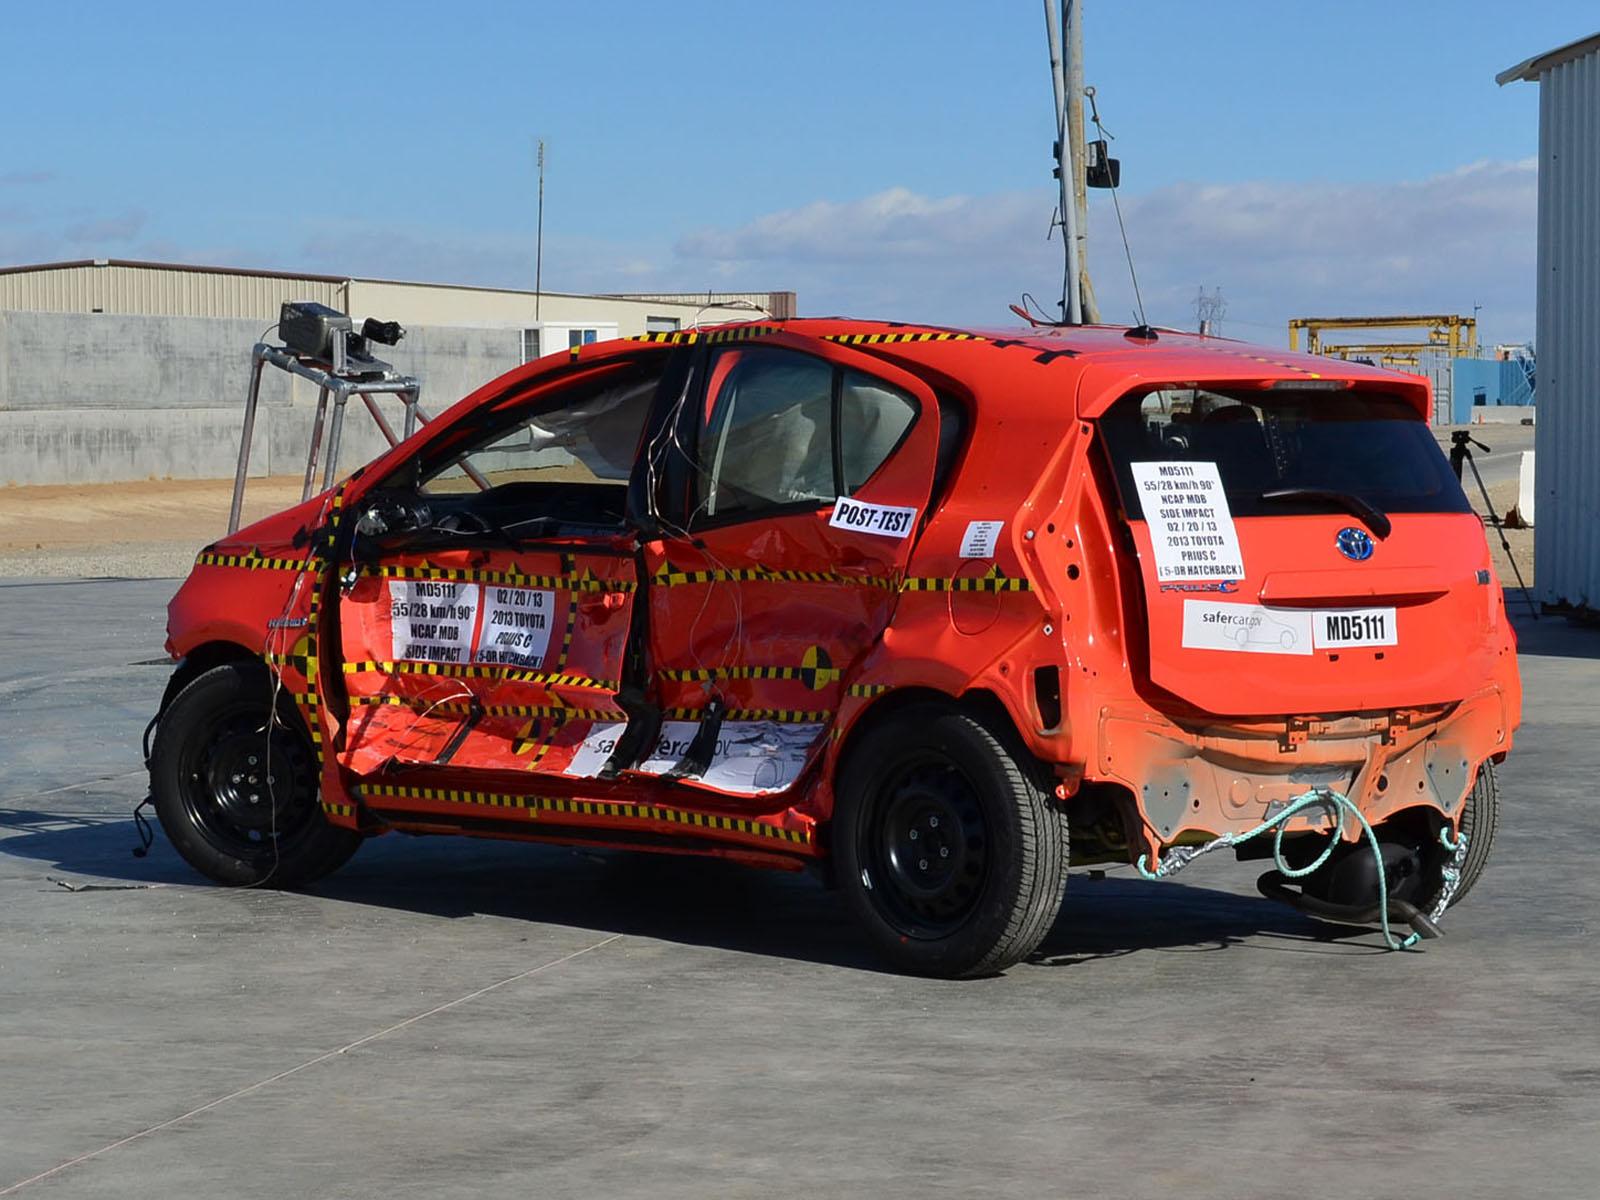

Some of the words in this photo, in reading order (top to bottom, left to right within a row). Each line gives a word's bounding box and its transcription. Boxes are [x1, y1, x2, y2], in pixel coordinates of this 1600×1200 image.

[1159, 466, 1194, 476] MD5111
[1144, 481, 1173, 491] 55/28
[1174, 481, 1199, 490] km/h
[1161, 494, 1185, 504] NCAP
[1187, 494, 1207, 504] MDB
[836, 502, 911, 532] POST-TEST
[1160, 509, 1181, 519] SIDE
[1182, 508, 1215, 518] IMPACT
[1167, 536, 1190, 547] 2013
[1190, 536, 1225, 546] TOYOTA
[1181, 551, 1209, 561] PRIUS
[1210, 551, 1217, 561] C
[415, 583, 456, 598] MD5111
[392, 602, 428, 617] 55/28
[430, 604, 456, 619] km/h
[491, 609, 513, 626] 2013
[514, 612, 545, 629] TOYOTA
[410, 623, 438, 639] NCAP
[439, 625, 459, 640] MDB
[1326, 615, 1385, 641] MD5111
[523, 633, 533, 648] C
[404, 644, 427, 659] SIDE
[428, 646, 461, 661] IMPACT
